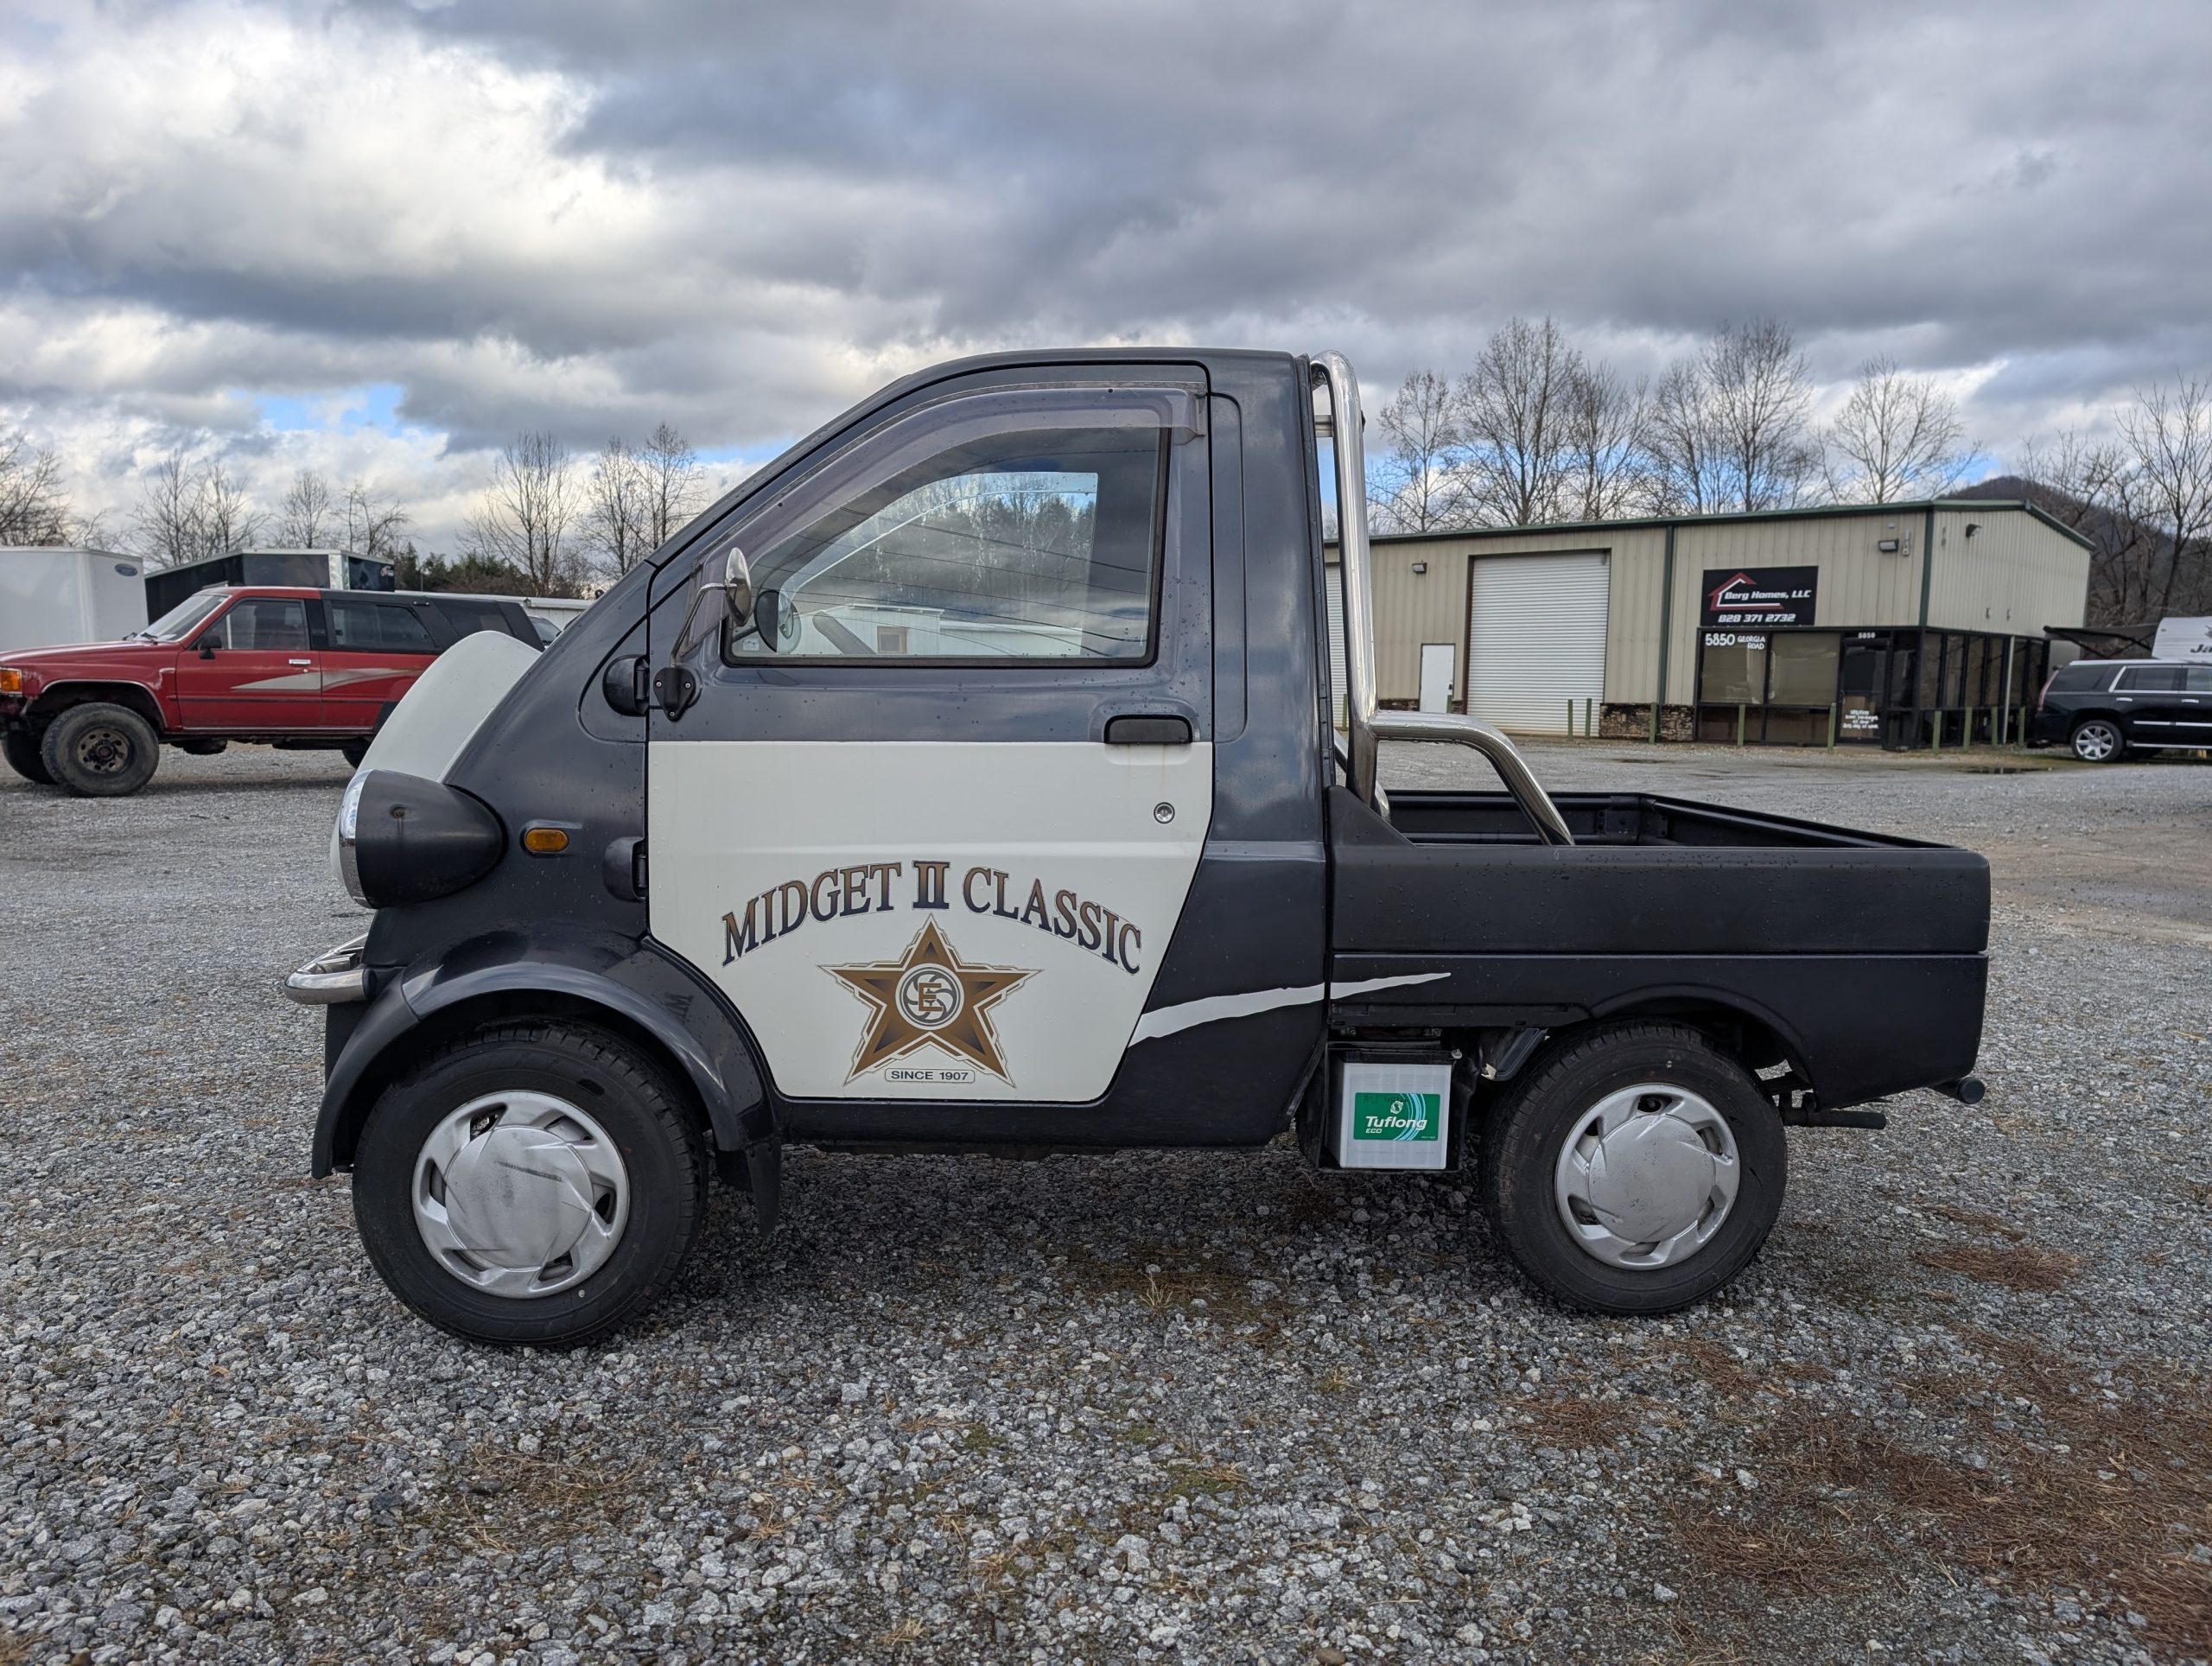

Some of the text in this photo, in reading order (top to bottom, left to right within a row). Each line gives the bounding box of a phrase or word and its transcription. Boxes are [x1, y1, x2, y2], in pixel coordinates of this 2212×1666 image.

[1725, 589, 1812, 601] Berg Homes, LLC
[1718, 613, 1796, 623] 828 371 2732
[1705, 633, 1736, 646] 5850
[721, 860, 1142, 976] MIDGET II CLASSIC
[891, 1070, 969, 1081] SINCE 1907
[1365, 1116, 1427, 1131] Tuflong
